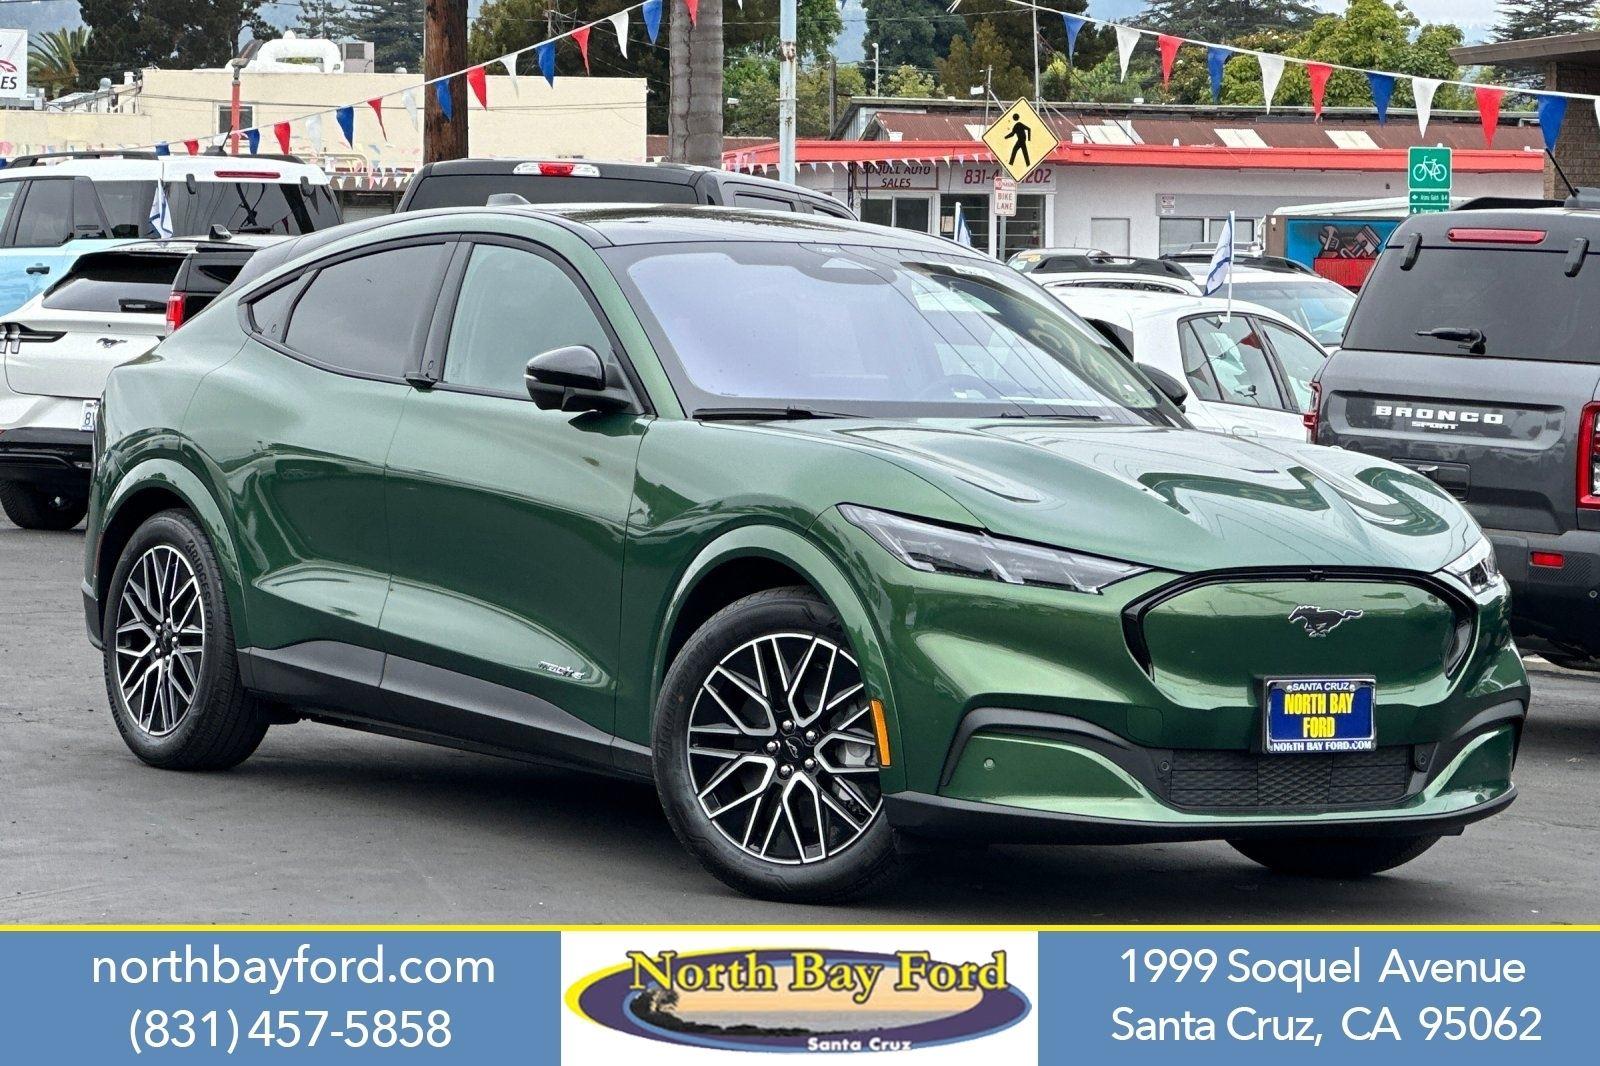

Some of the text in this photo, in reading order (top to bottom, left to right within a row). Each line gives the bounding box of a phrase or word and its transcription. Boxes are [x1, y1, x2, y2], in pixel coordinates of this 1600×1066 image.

[904, 165, 931, 175] AUTO
[881, 178, 911, 188] SALES
[997, 192, 1013, 201] BIKE
[996, 202, 1014, 211] LANE
[1375, 405, 1504, 425] BRONCO
[1411, 420, 1459, 430] SPORT
[1292, 682, 1350, 691] SANTA CRUZ
[1284, 692, 1355, 715] NORTH BAY
[1303, 716, 1336, 738] FORD
[1273, 740, 1372, 752] NORTH BAY FORD.COM
